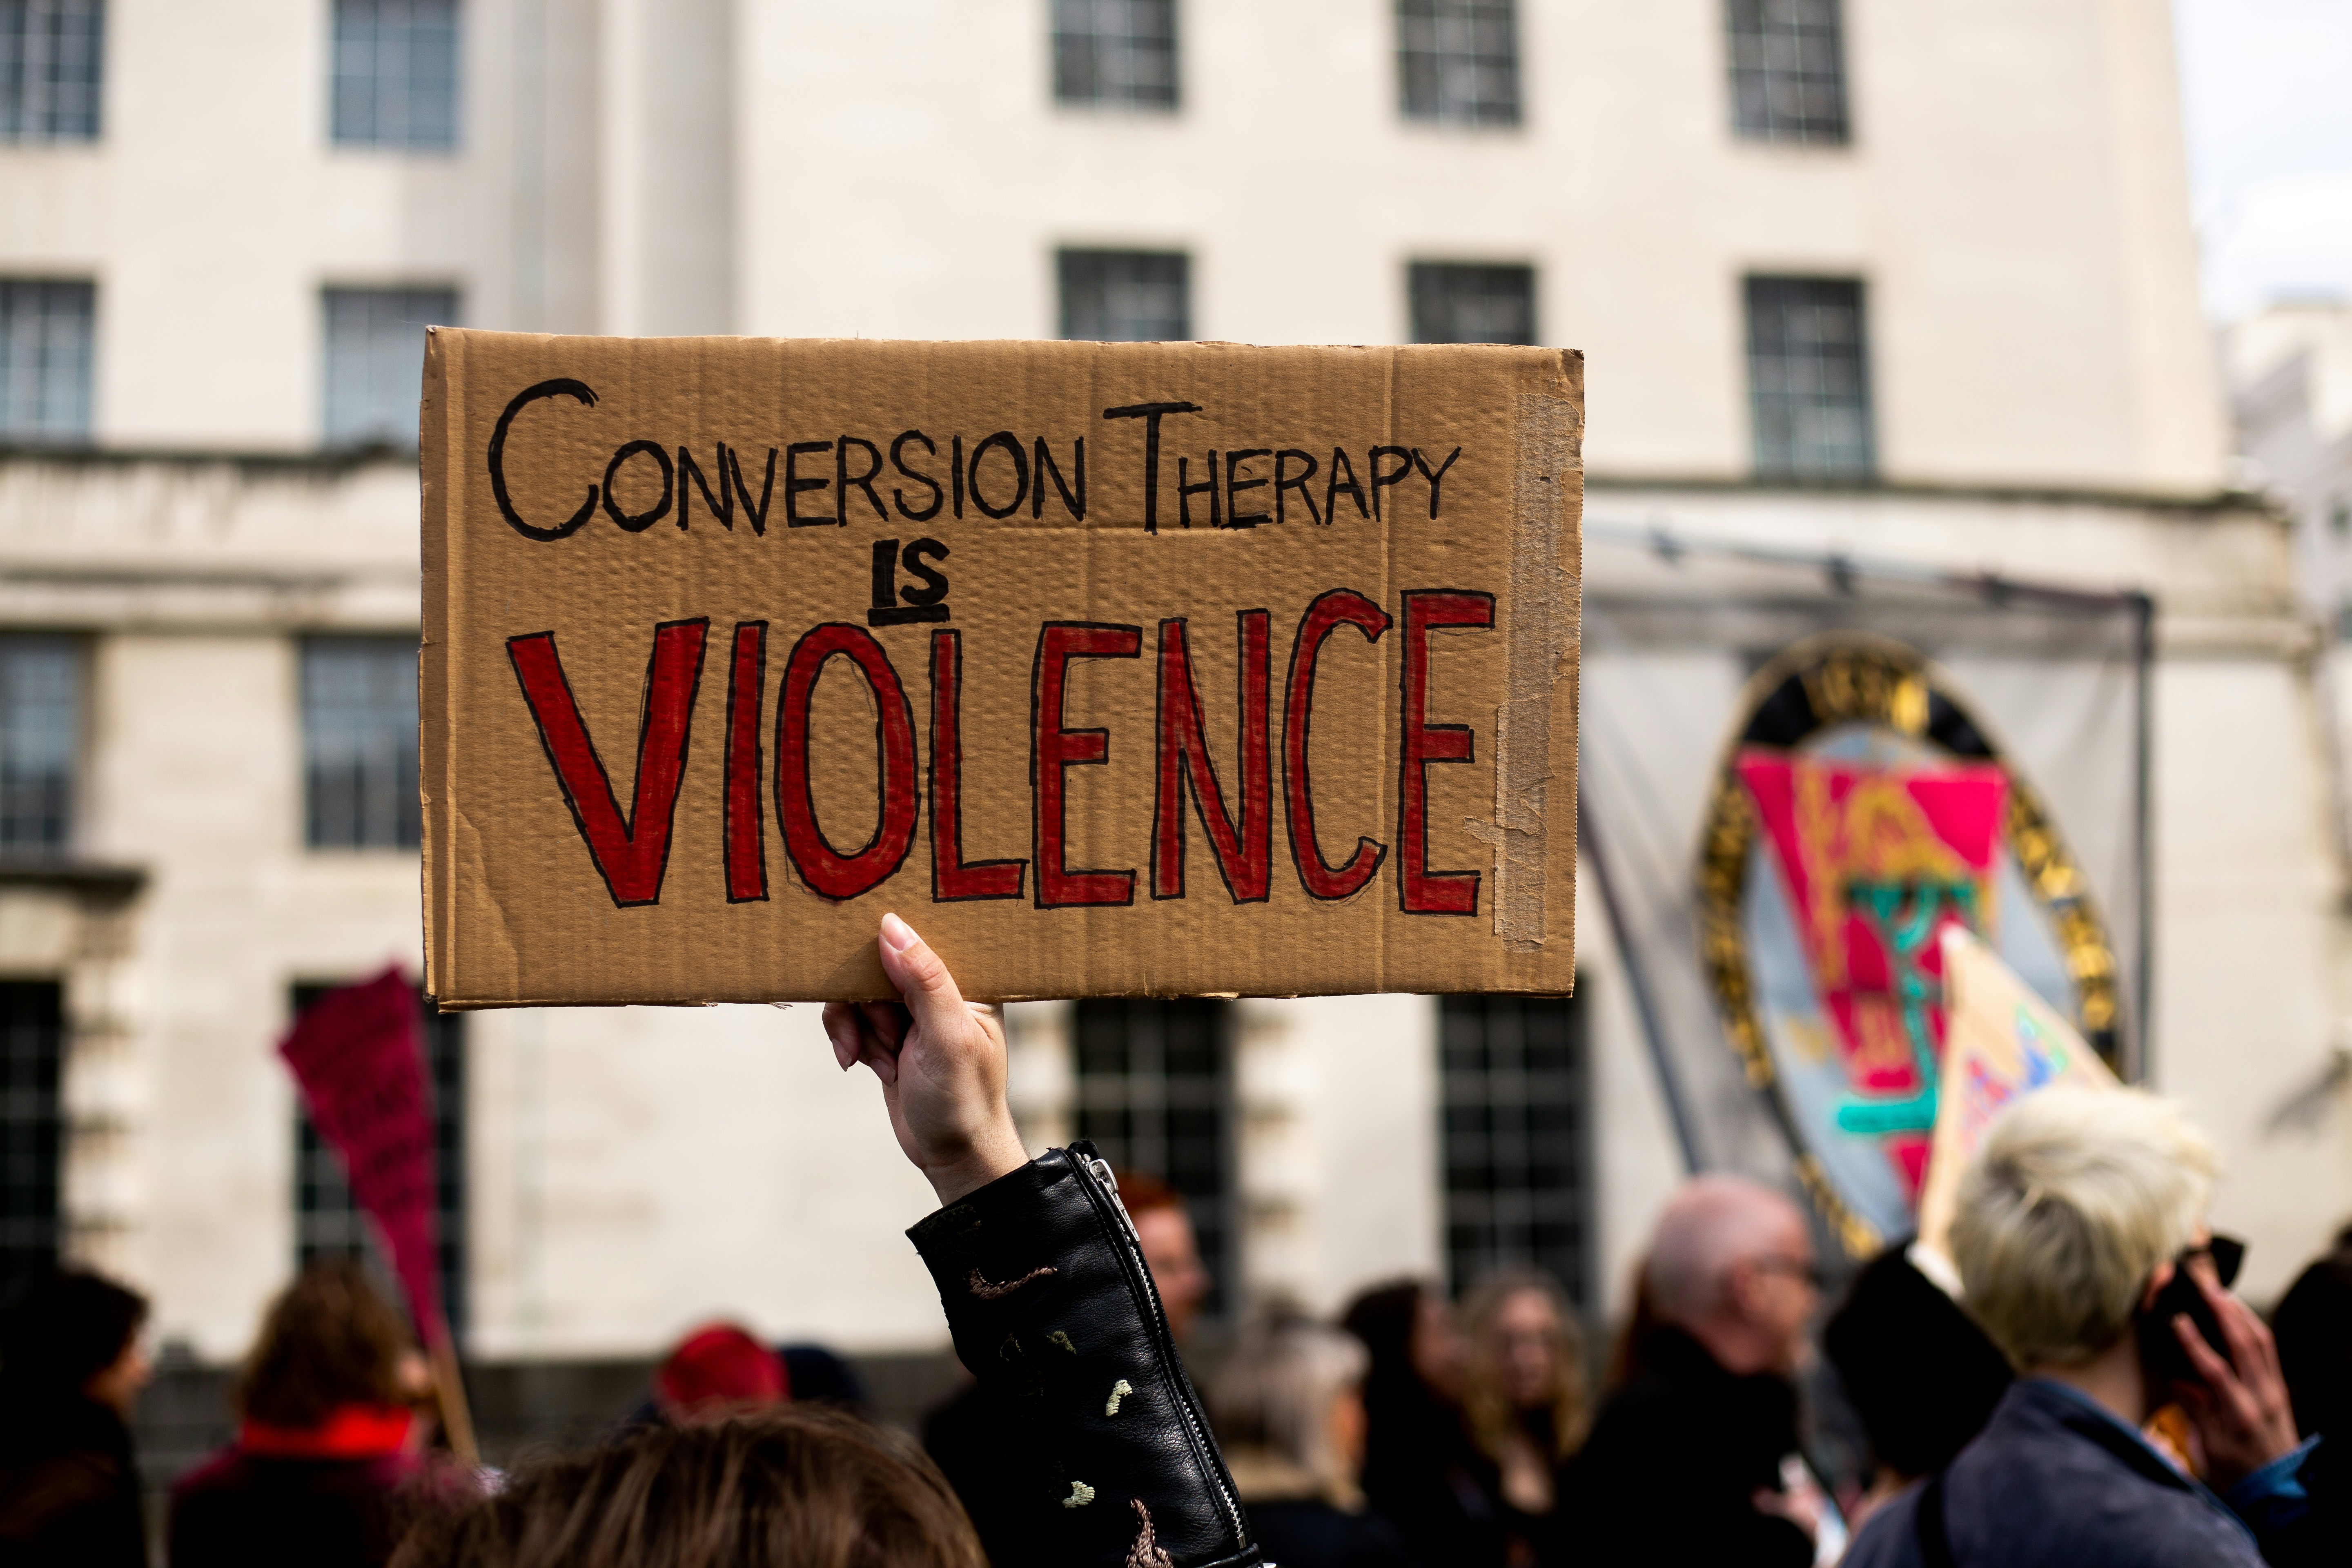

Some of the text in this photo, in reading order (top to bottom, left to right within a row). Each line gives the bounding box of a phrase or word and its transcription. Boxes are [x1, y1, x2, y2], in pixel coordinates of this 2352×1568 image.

[488, 378, 1462, 542] CONVERSION THERAPY
[870, 537, 951, 609] IS
[506, 588, 1496, 915] VIOLENCE
